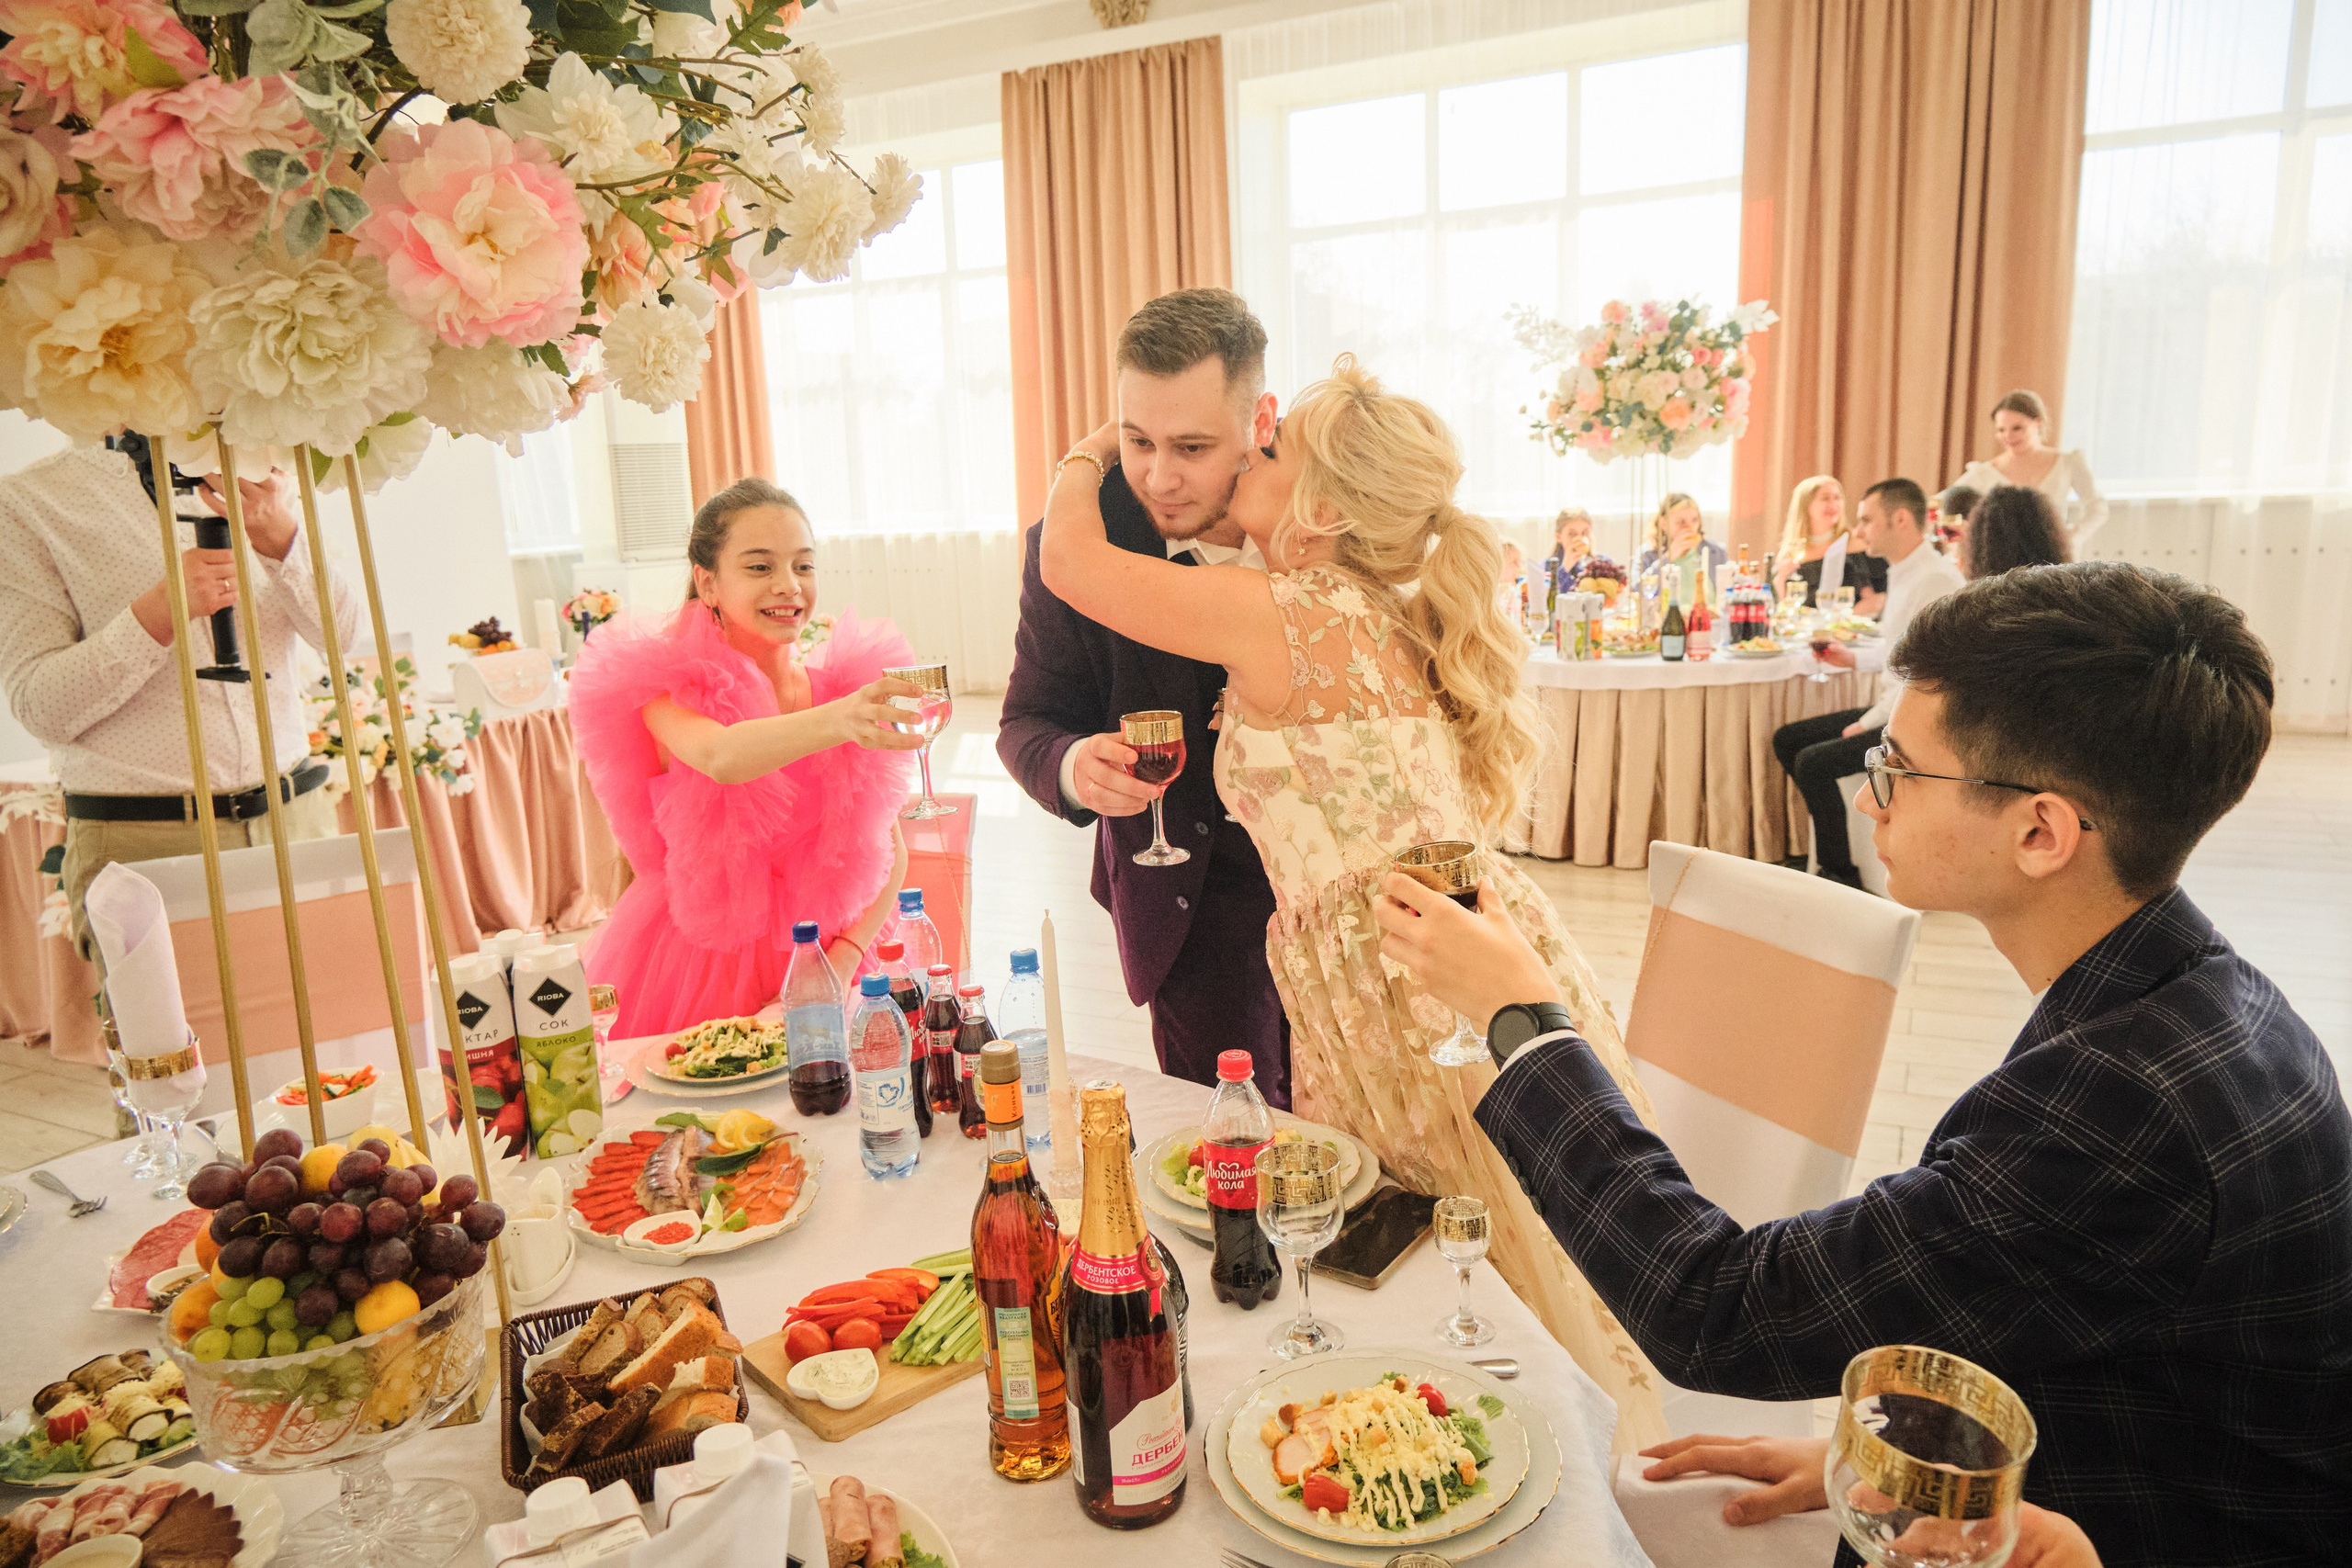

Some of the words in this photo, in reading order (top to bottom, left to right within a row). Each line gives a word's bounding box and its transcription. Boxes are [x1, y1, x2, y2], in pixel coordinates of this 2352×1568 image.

[537, 992, 564, 1001] RIOBA
[539, 1019, 569, 1031] СОК
[465, 1029, 498, 1043] КТАР
[537, 1035, 576, 1047] ЯБЛОКО
[466, 1049, 494, 1060] ИШНЯ
[1206, 1160, 1257, 1179] Любимая
[1217, 1179, 1245, 1190] кола
[1077, 1258, 1136, 1278] ДЕРБЕНТСКОЕ
[1086, 1275, 1119, 1284] РОЗОВОЕ
[1132, 1429, 1183, 1466] ДЕРБЕН
